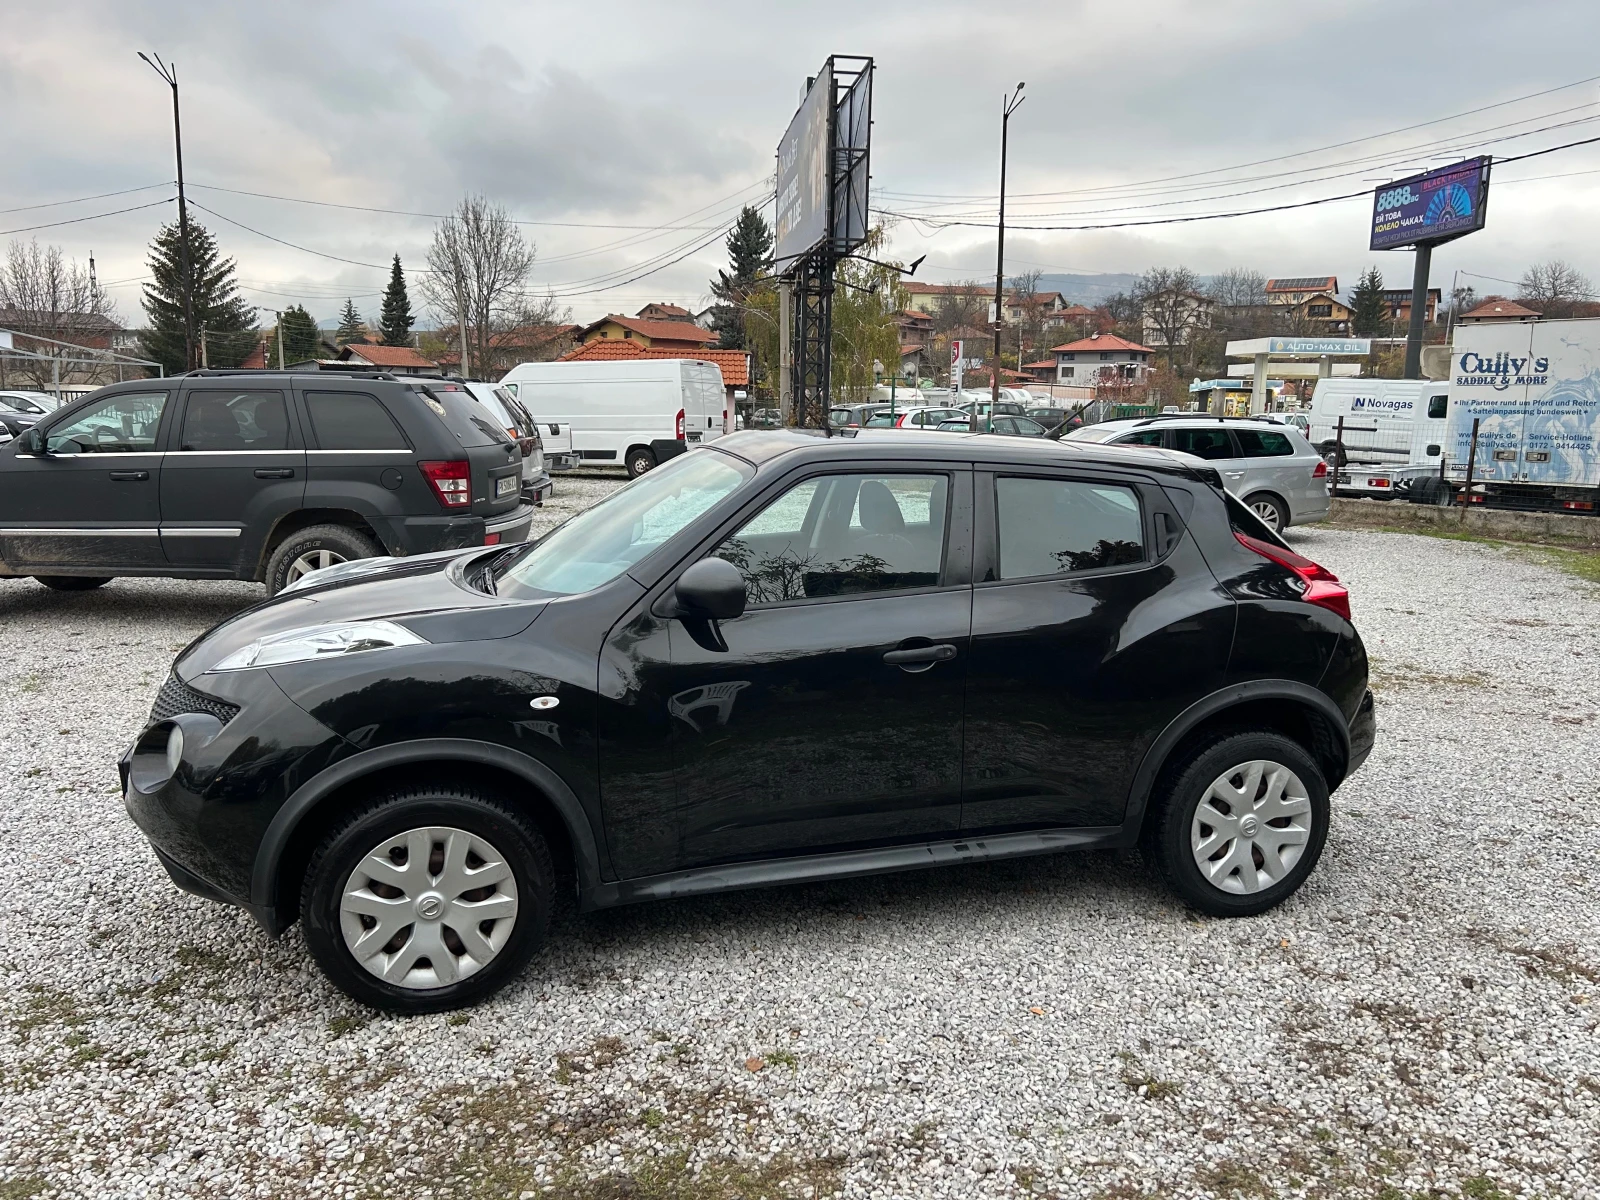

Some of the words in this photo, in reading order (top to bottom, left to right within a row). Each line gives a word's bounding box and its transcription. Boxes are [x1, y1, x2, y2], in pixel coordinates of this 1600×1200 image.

[1423, 177, 1446, 190] BLACK
[1375, 213, 1384, 224] ЕЙ
[1385, 210, 1402, 221] ТОВА
[1375, 221, 1400, 233] КОЛЕЛО
[1400, 214, 1424, 227] ЧАКАХ
[1456, 376, 1496, 385] SADDLE
[1500, 376, 1510, 385] &
[1515, 375, 1548, 385] MORE
[1367, 398, 1413, 411] Novagas
[1572, 400, 1597, 408] Reiter
[1472, 408, 1535, 416] Sattelanpassung
[1536, 408, 1582, 416] bundesweit
[1458, 432, 1517, 440] ww.cullys.de
[1528, 433, 1593, 441] Service-Hotline
